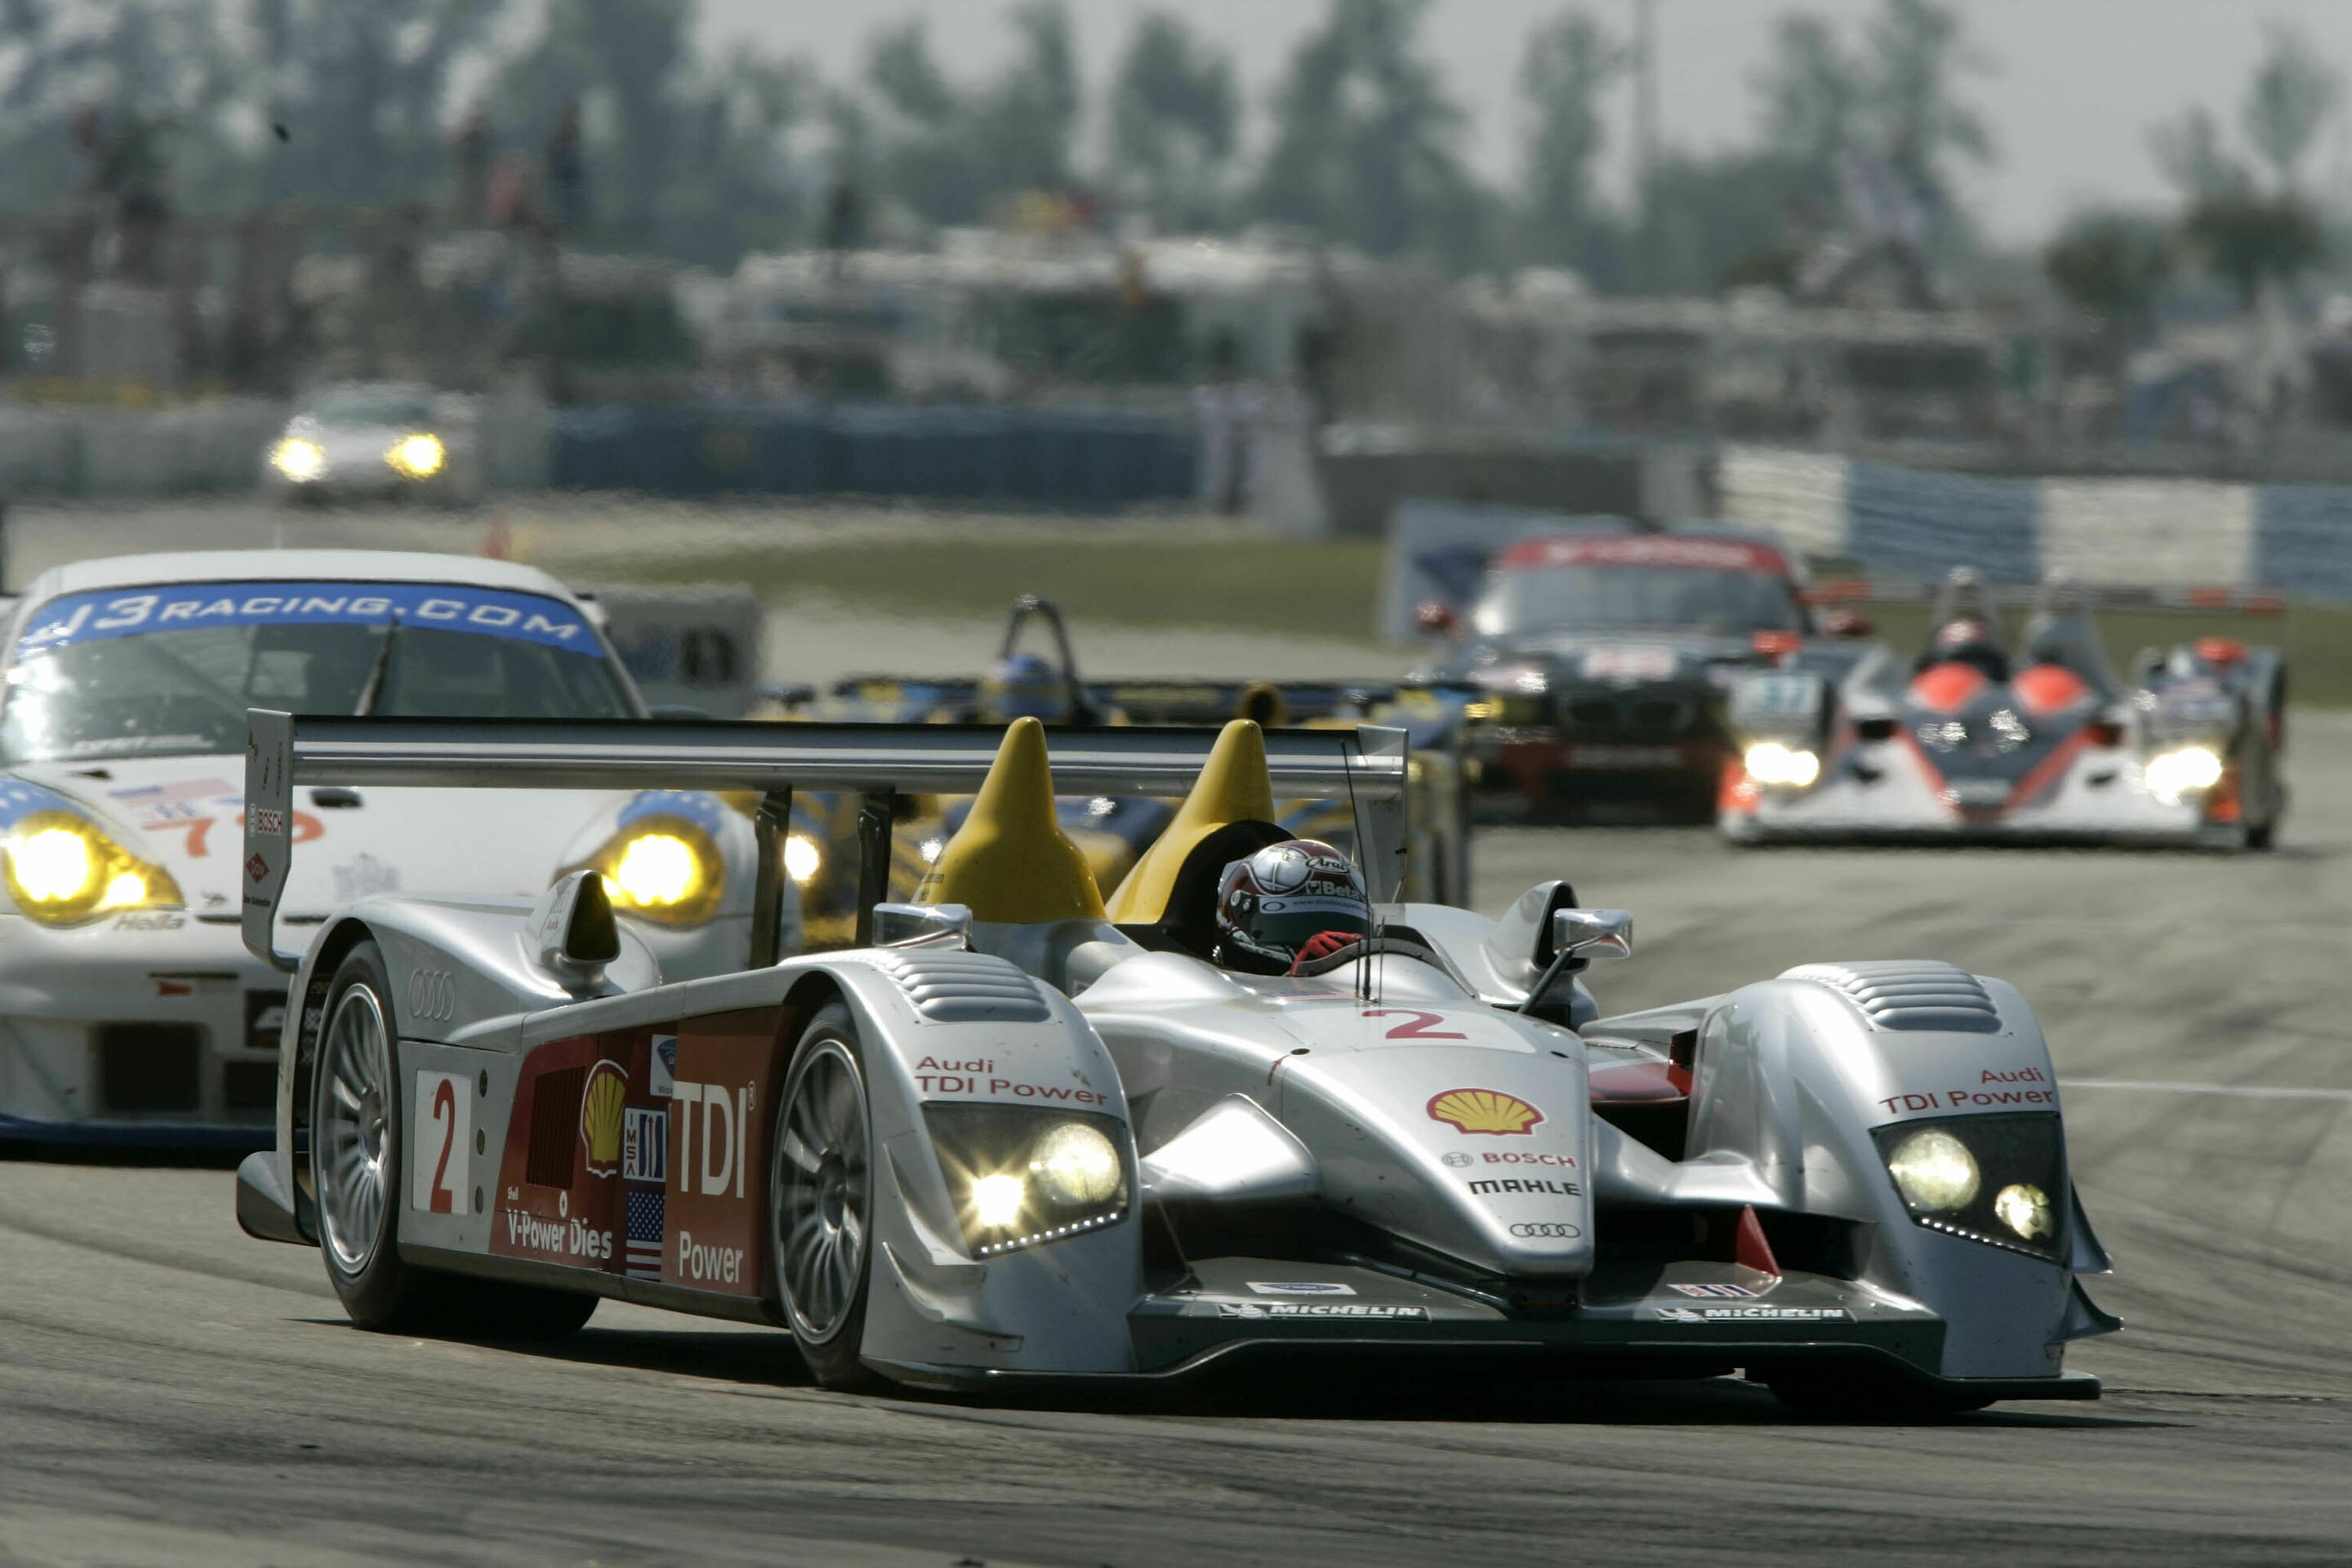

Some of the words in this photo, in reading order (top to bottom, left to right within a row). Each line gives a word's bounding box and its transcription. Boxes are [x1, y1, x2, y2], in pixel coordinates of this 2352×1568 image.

[258, 808, 283, 835] BOSCH
[1361, 1009, 1468, 1040] 2
[916, 1056, 994, 1074] Audi
[1980, 1067, 2045, 1085] Audi
[915, 1076, 974, 1094] TDI
[990, 1080, 1109, 1106] Power
[1879, 1093, 1939, 1116] TDI
[1946, 1088, 2054, 1108] Power
[430, 1079, 455, 1214] 2
[626, 1111, 637, 1177] IMSA
[1482, 1152, 1578, 1169] BOSCH
[1468, 1178, 1581, 1197] MAHLE
[506, 1209, 566, 1253] V-Power
[678, 1230, 743, 1284] Power
[1269, 1305, 1422, 1316] MICHELIN
[1704, 1308, 1844, 1318] MICHELIN
